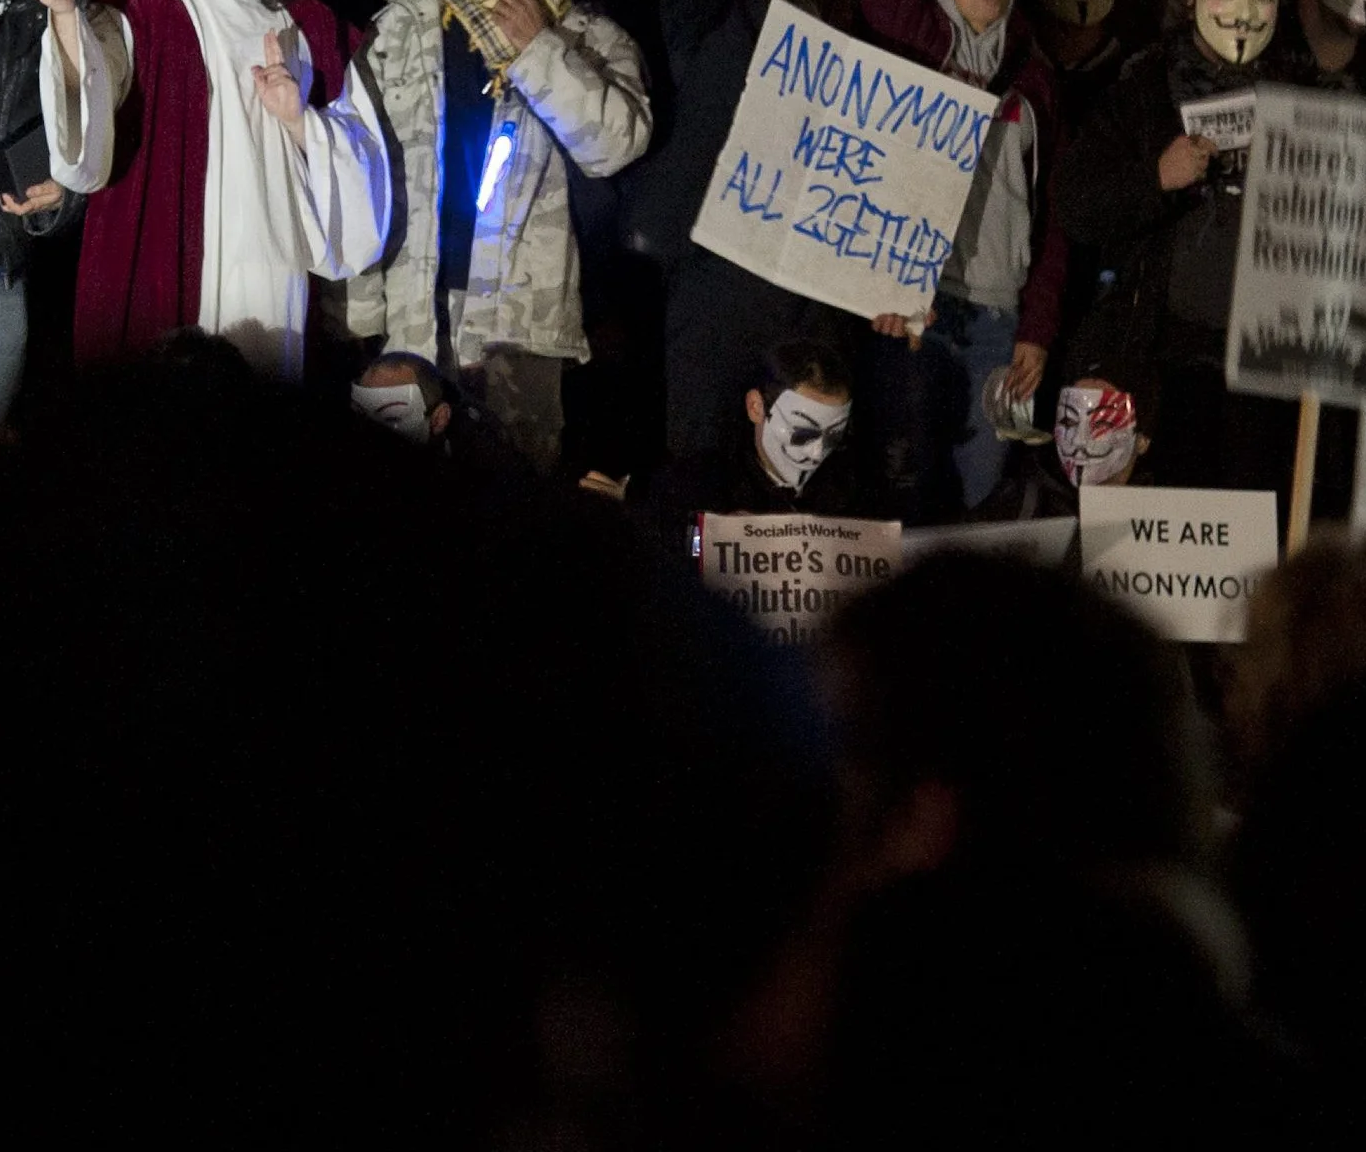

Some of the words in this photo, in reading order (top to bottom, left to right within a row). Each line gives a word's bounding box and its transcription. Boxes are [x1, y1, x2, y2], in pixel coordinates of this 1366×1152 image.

[760, 23, 992, 173] ANONYMOUS
[793, 116, 887, 186] WERE
[722, 150, 784, 222] ALL
[744, 524, 809, 539] Socialist
[808, 524, 862, 541] Worker
[1130, 519, 1169, 543] WE
[1178, 521, 1230, 547] ARE
[713, 541, 825, 575] There's
[835, 552, 891, 579] one
